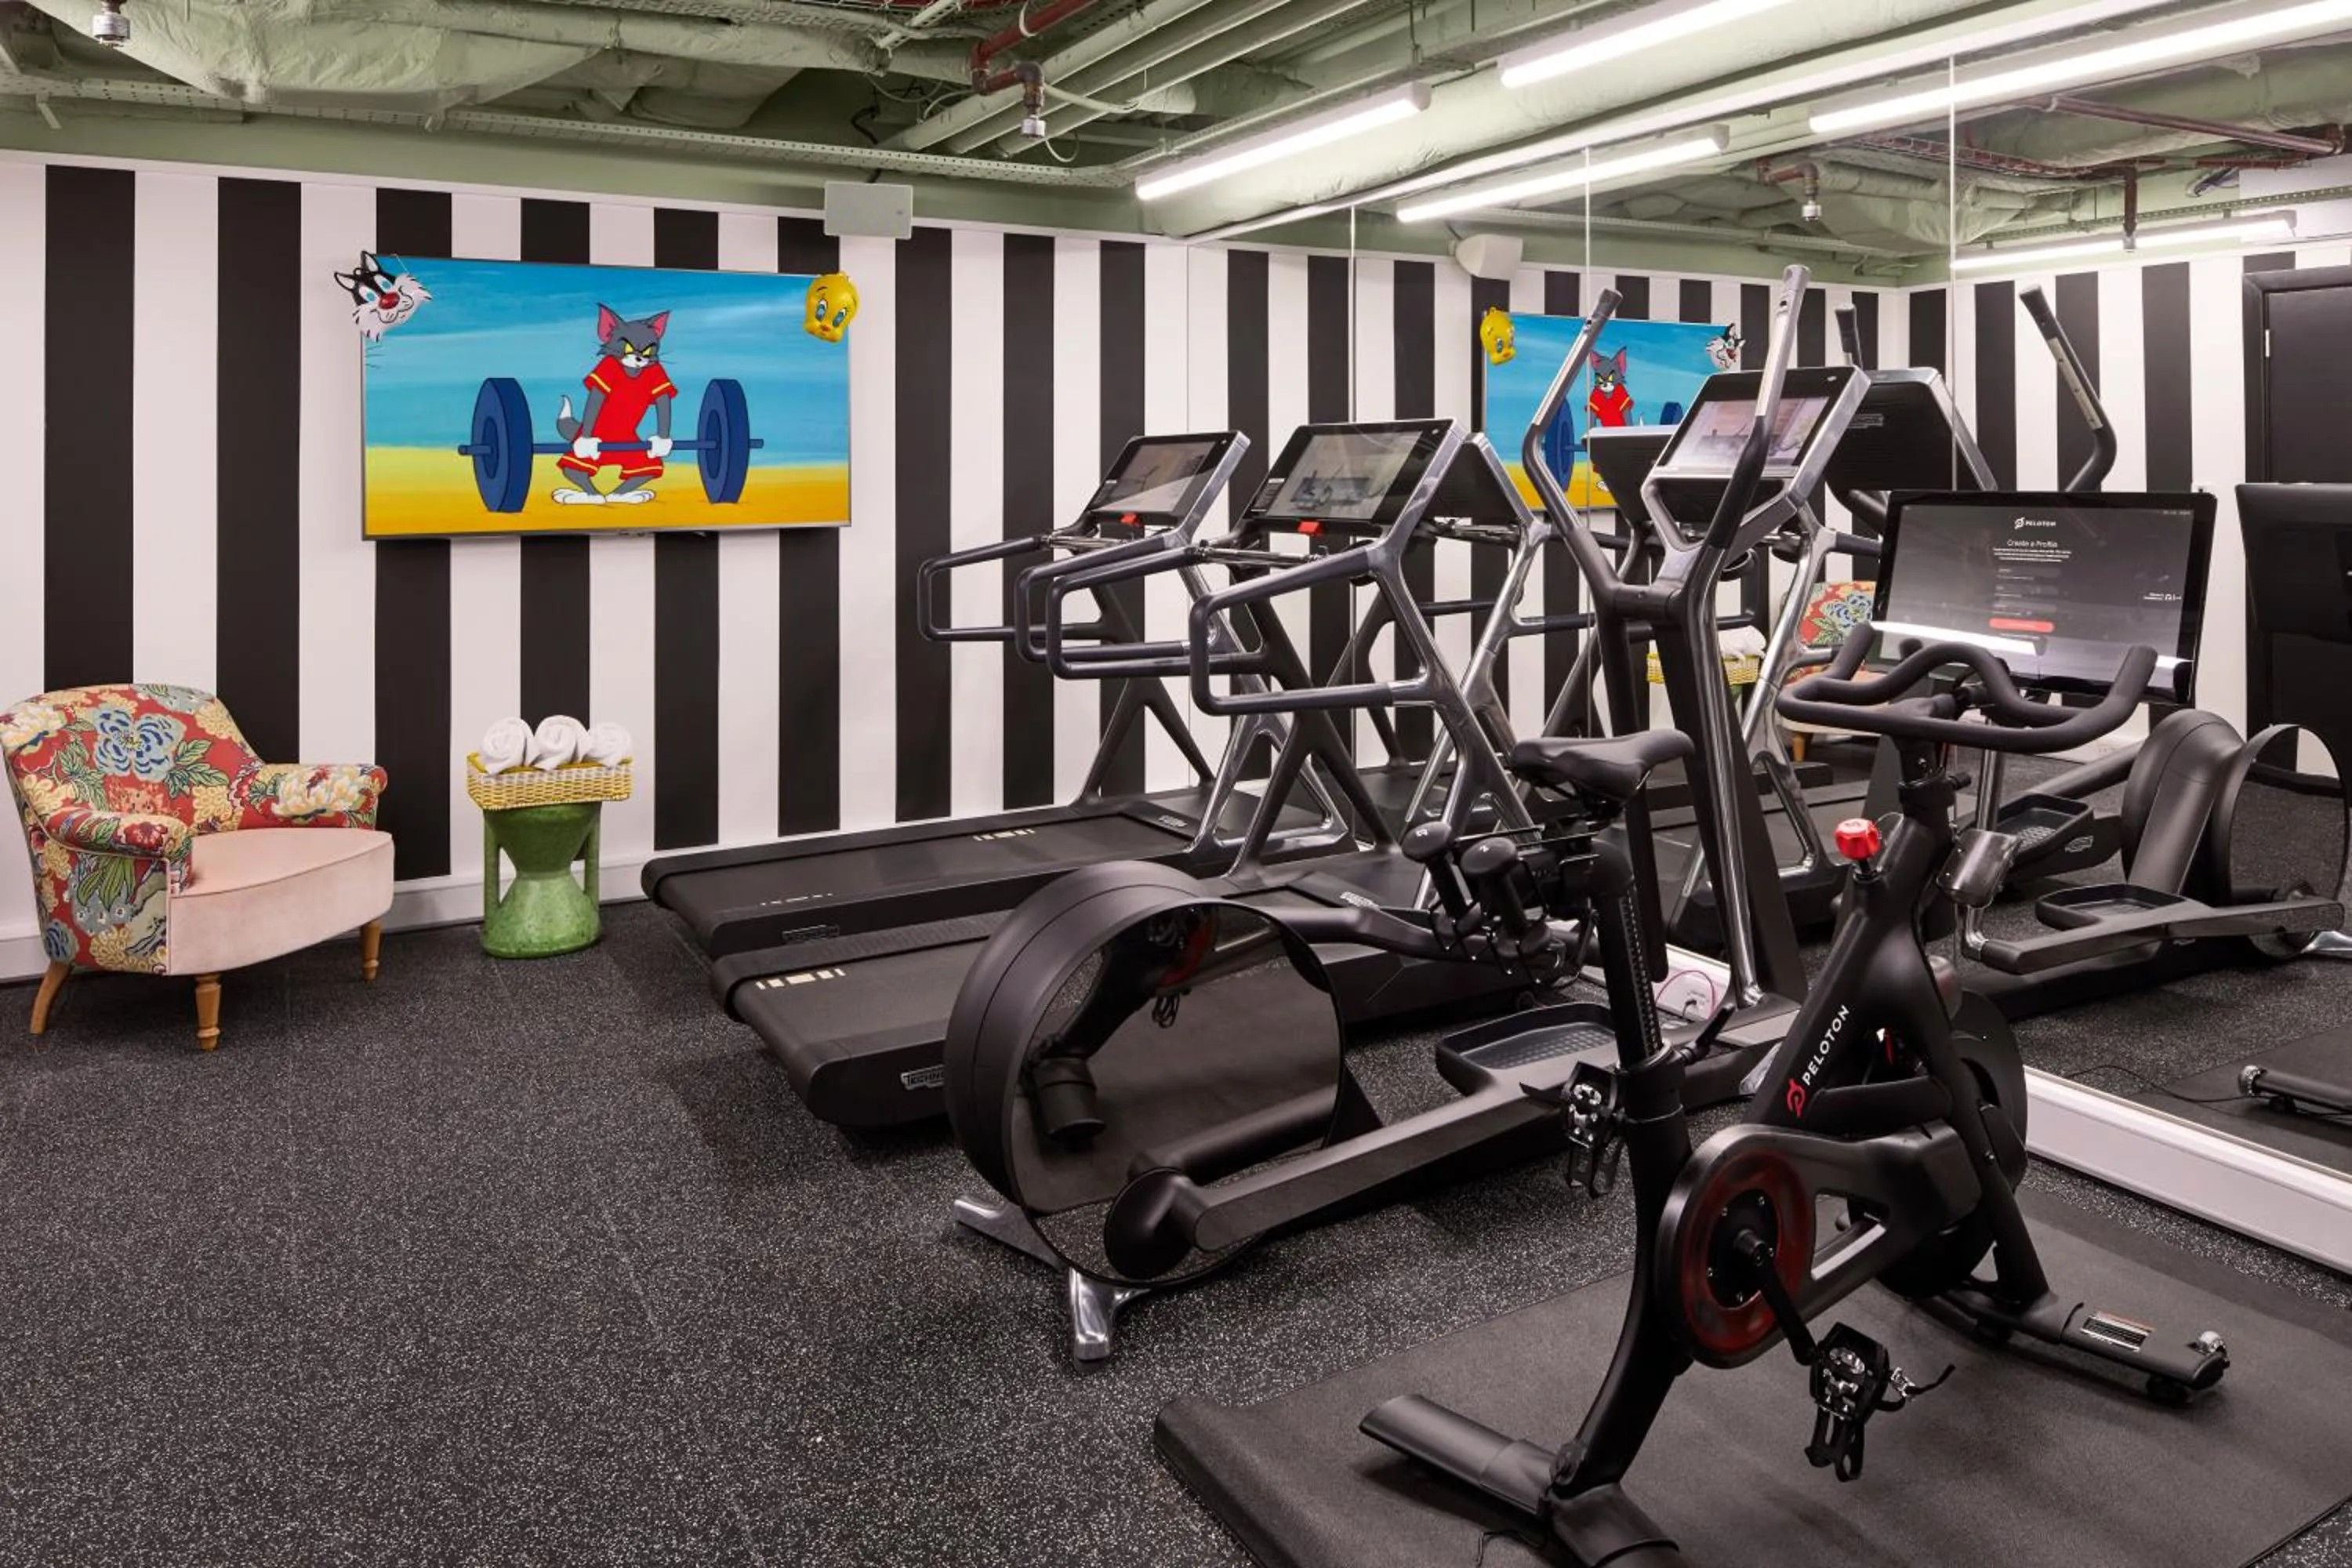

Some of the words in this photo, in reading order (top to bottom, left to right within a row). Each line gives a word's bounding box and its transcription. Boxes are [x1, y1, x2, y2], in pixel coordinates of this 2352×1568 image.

[2025, 519, 2056, 528] PELOTON
[2007, 539, 2029, 547] Create
[1802, 1004, 1851, 1086] PELOTON
